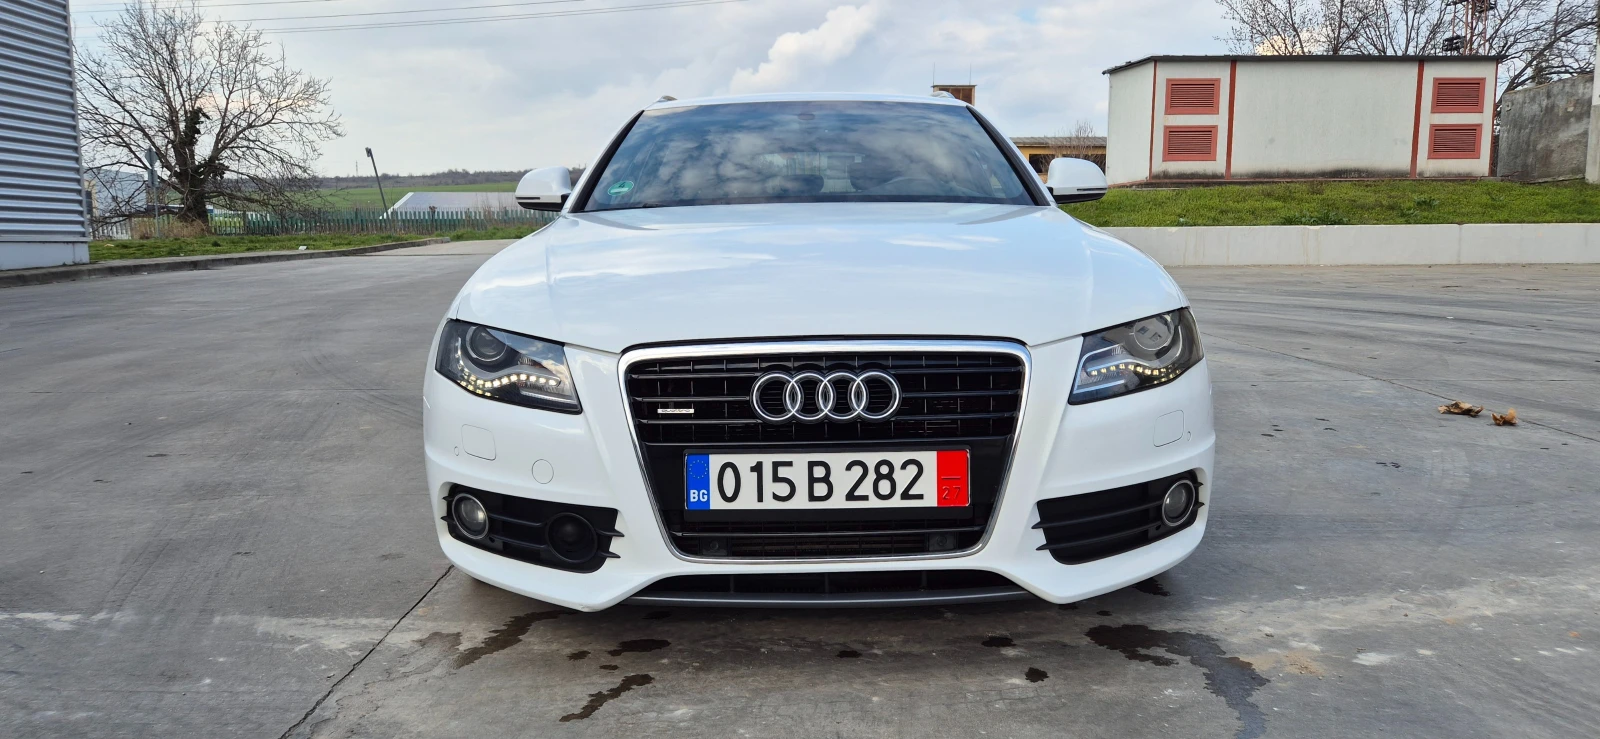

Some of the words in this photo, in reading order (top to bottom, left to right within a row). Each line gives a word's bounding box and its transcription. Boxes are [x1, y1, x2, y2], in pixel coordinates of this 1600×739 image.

[717, 460, 796, 502] 015
[807, 460, 834, 502] B
[845, 458, 924, 501] 282
[690, 489, 708, 502] BG
[942, 485, 961, 500] 27
